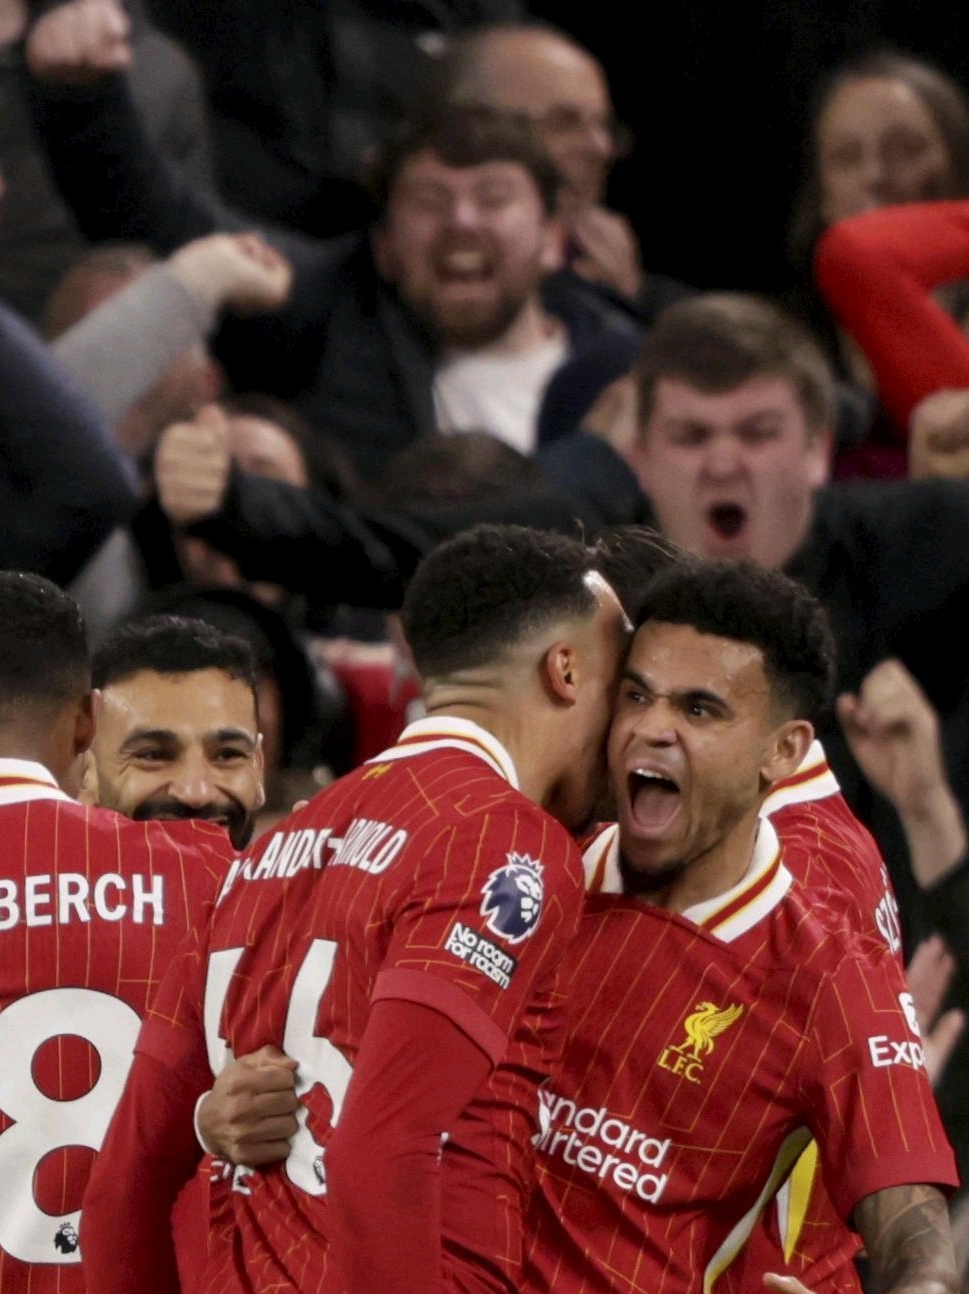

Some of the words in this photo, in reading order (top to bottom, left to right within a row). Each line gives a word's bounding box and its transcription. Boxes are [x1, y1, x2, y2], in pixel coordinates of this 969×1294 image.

[448, 921, 478, 947] No
[477, 939, 514, 973] room
[531, 1127, 669, 1205] rtered
[538, 1088, 673, 1168] ndard
